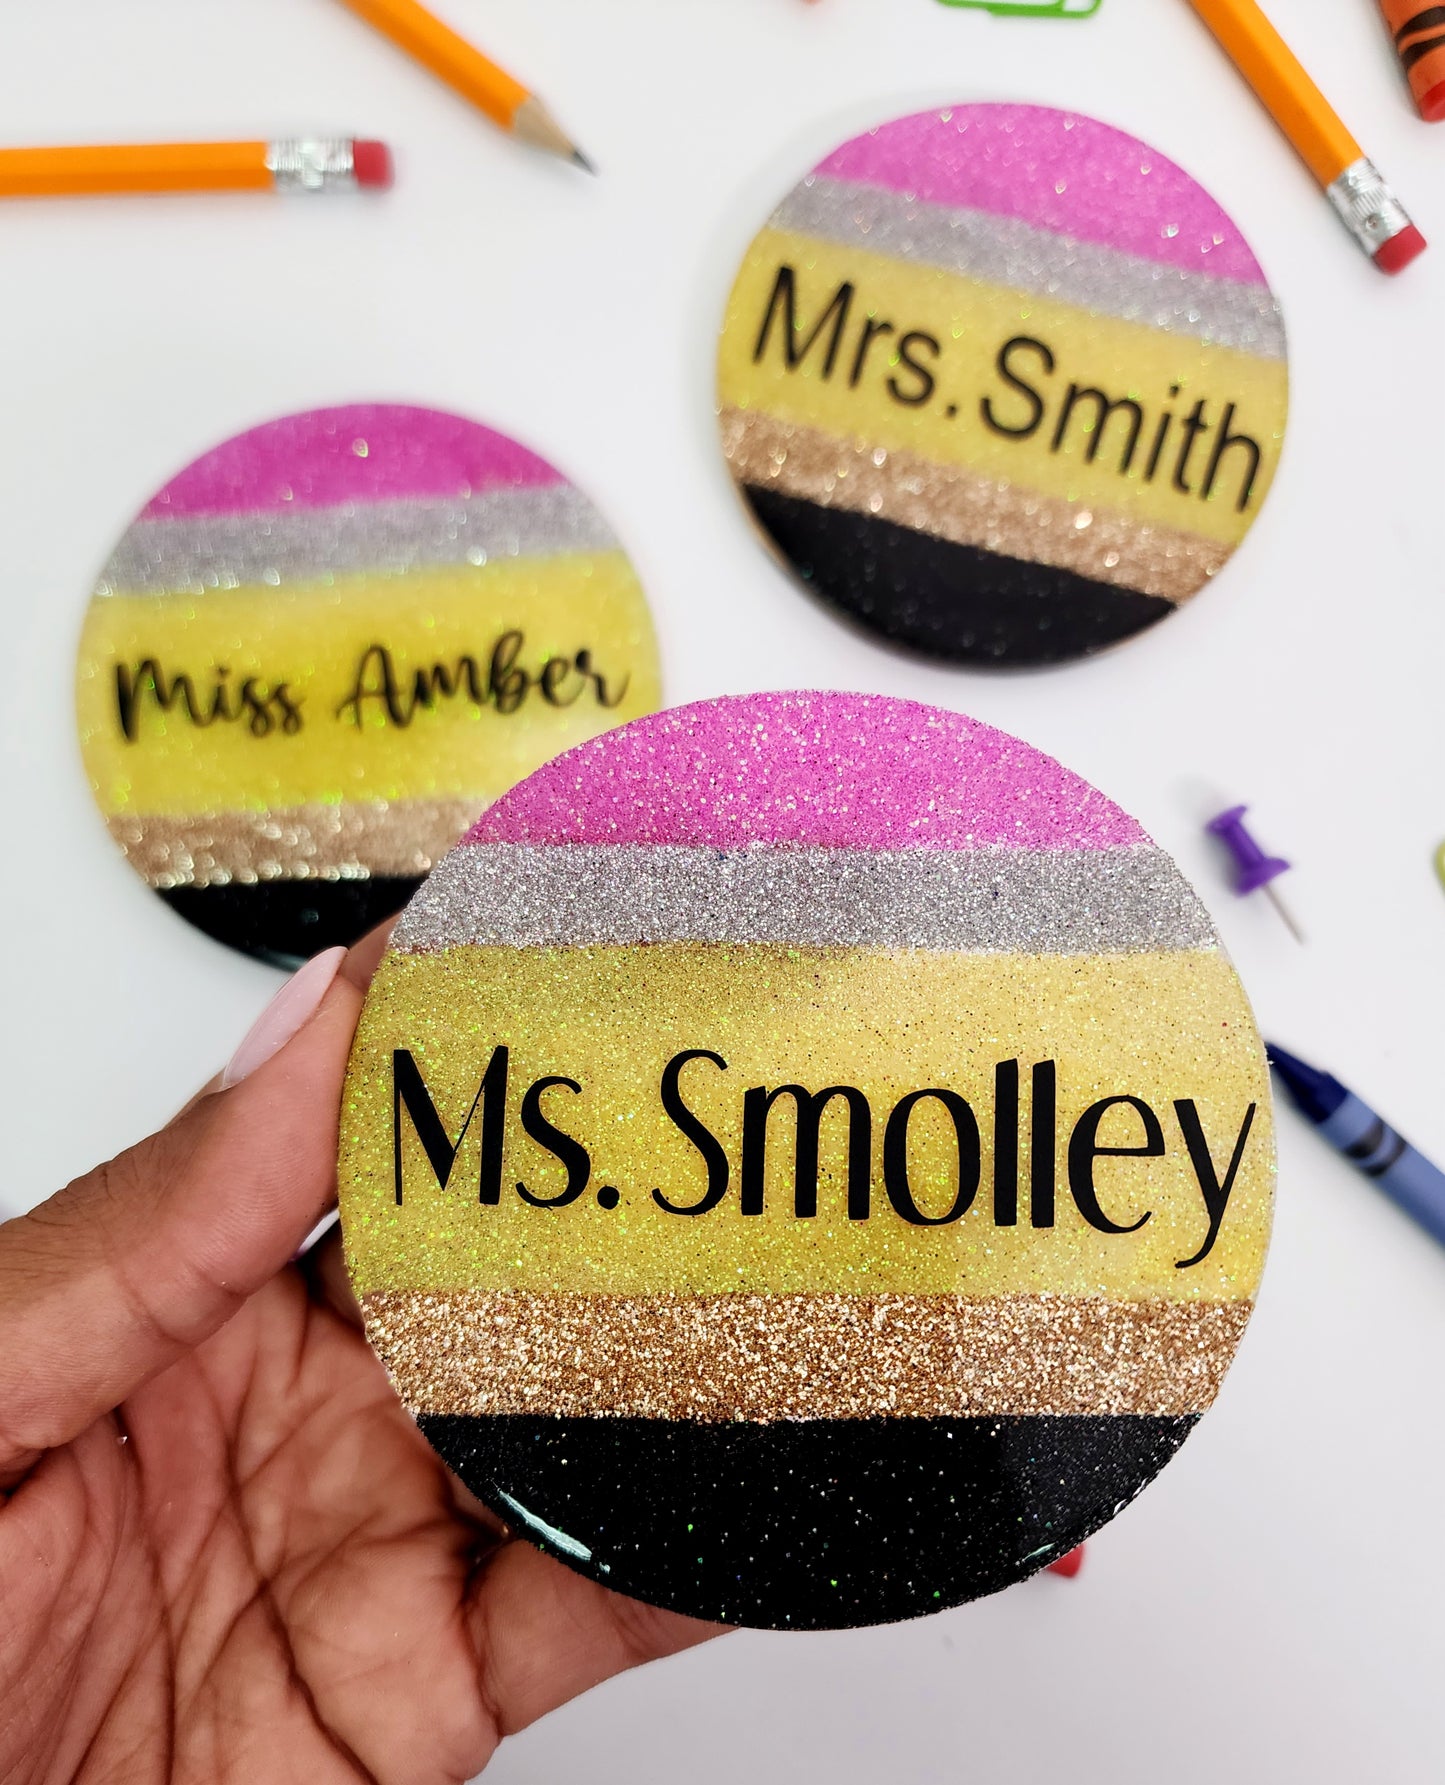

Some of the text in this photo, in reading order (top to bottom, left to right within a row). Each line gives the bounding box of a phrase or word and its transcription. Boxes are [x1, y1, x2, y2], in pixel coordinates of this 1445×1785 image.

[114, 630, 629, 744] Miss Amber
[394, 1045, 1257, 1269] Ms. Smolley
